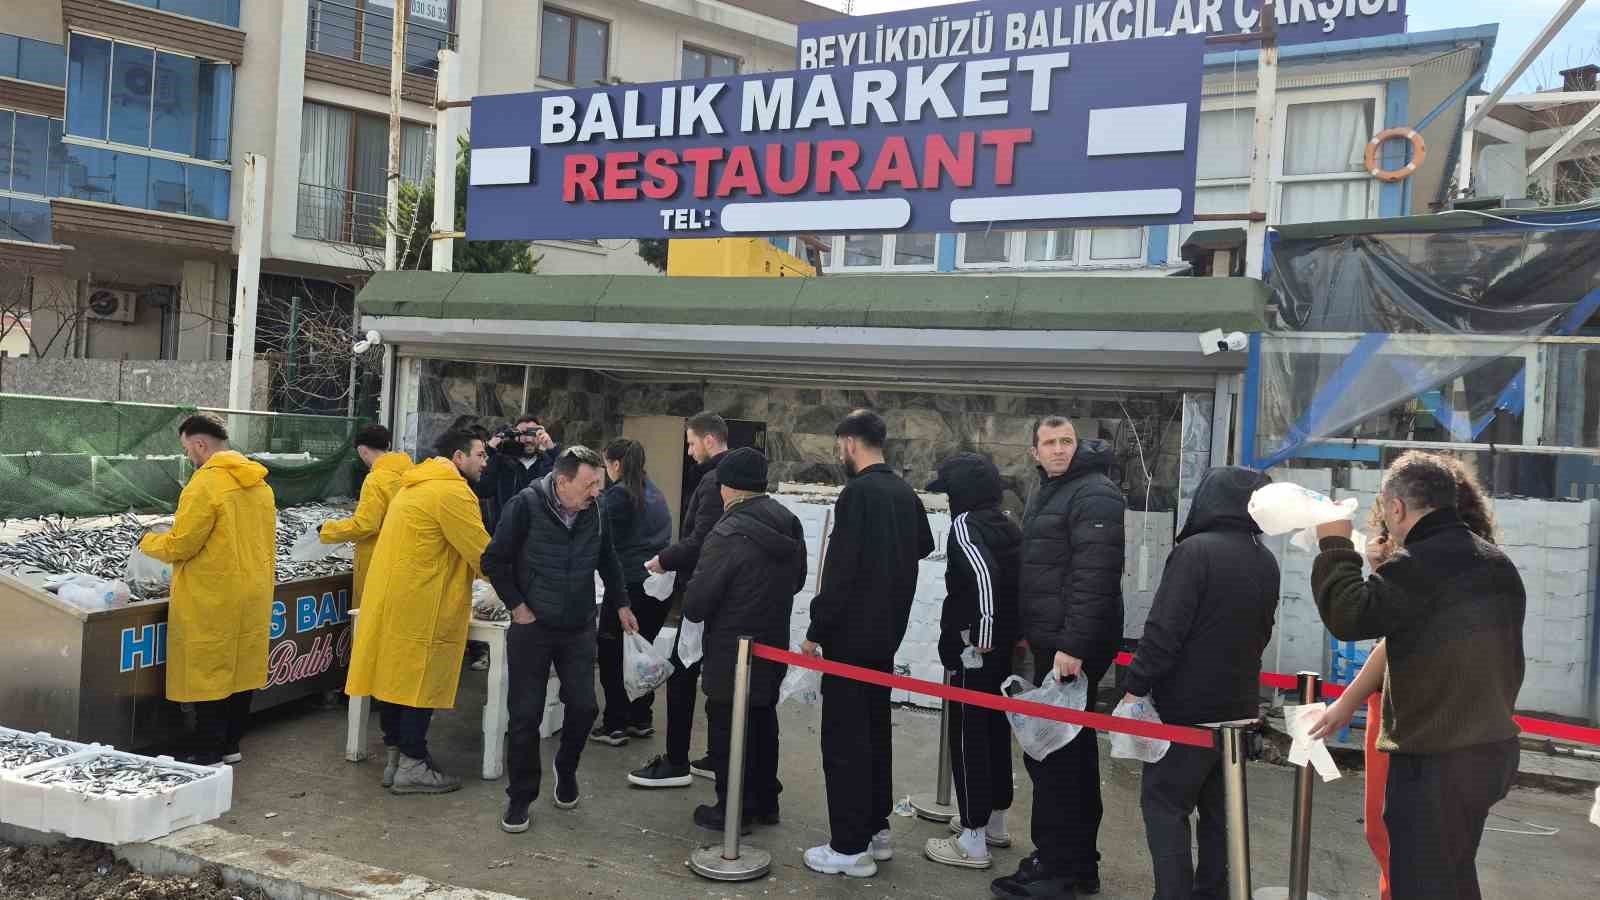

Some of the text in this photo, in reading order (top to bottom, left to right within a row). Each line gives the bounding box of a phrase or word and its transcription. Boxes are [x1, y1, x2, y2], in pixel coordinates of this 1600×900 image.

[800, 10, 993, 70] BEYLİKDÜZÜ
[540, 52, 1070, 144] BALIK MARKET
[562, 128, 1033, 202] RESTAURANT
[660, 208, 711, 230] TEL:
